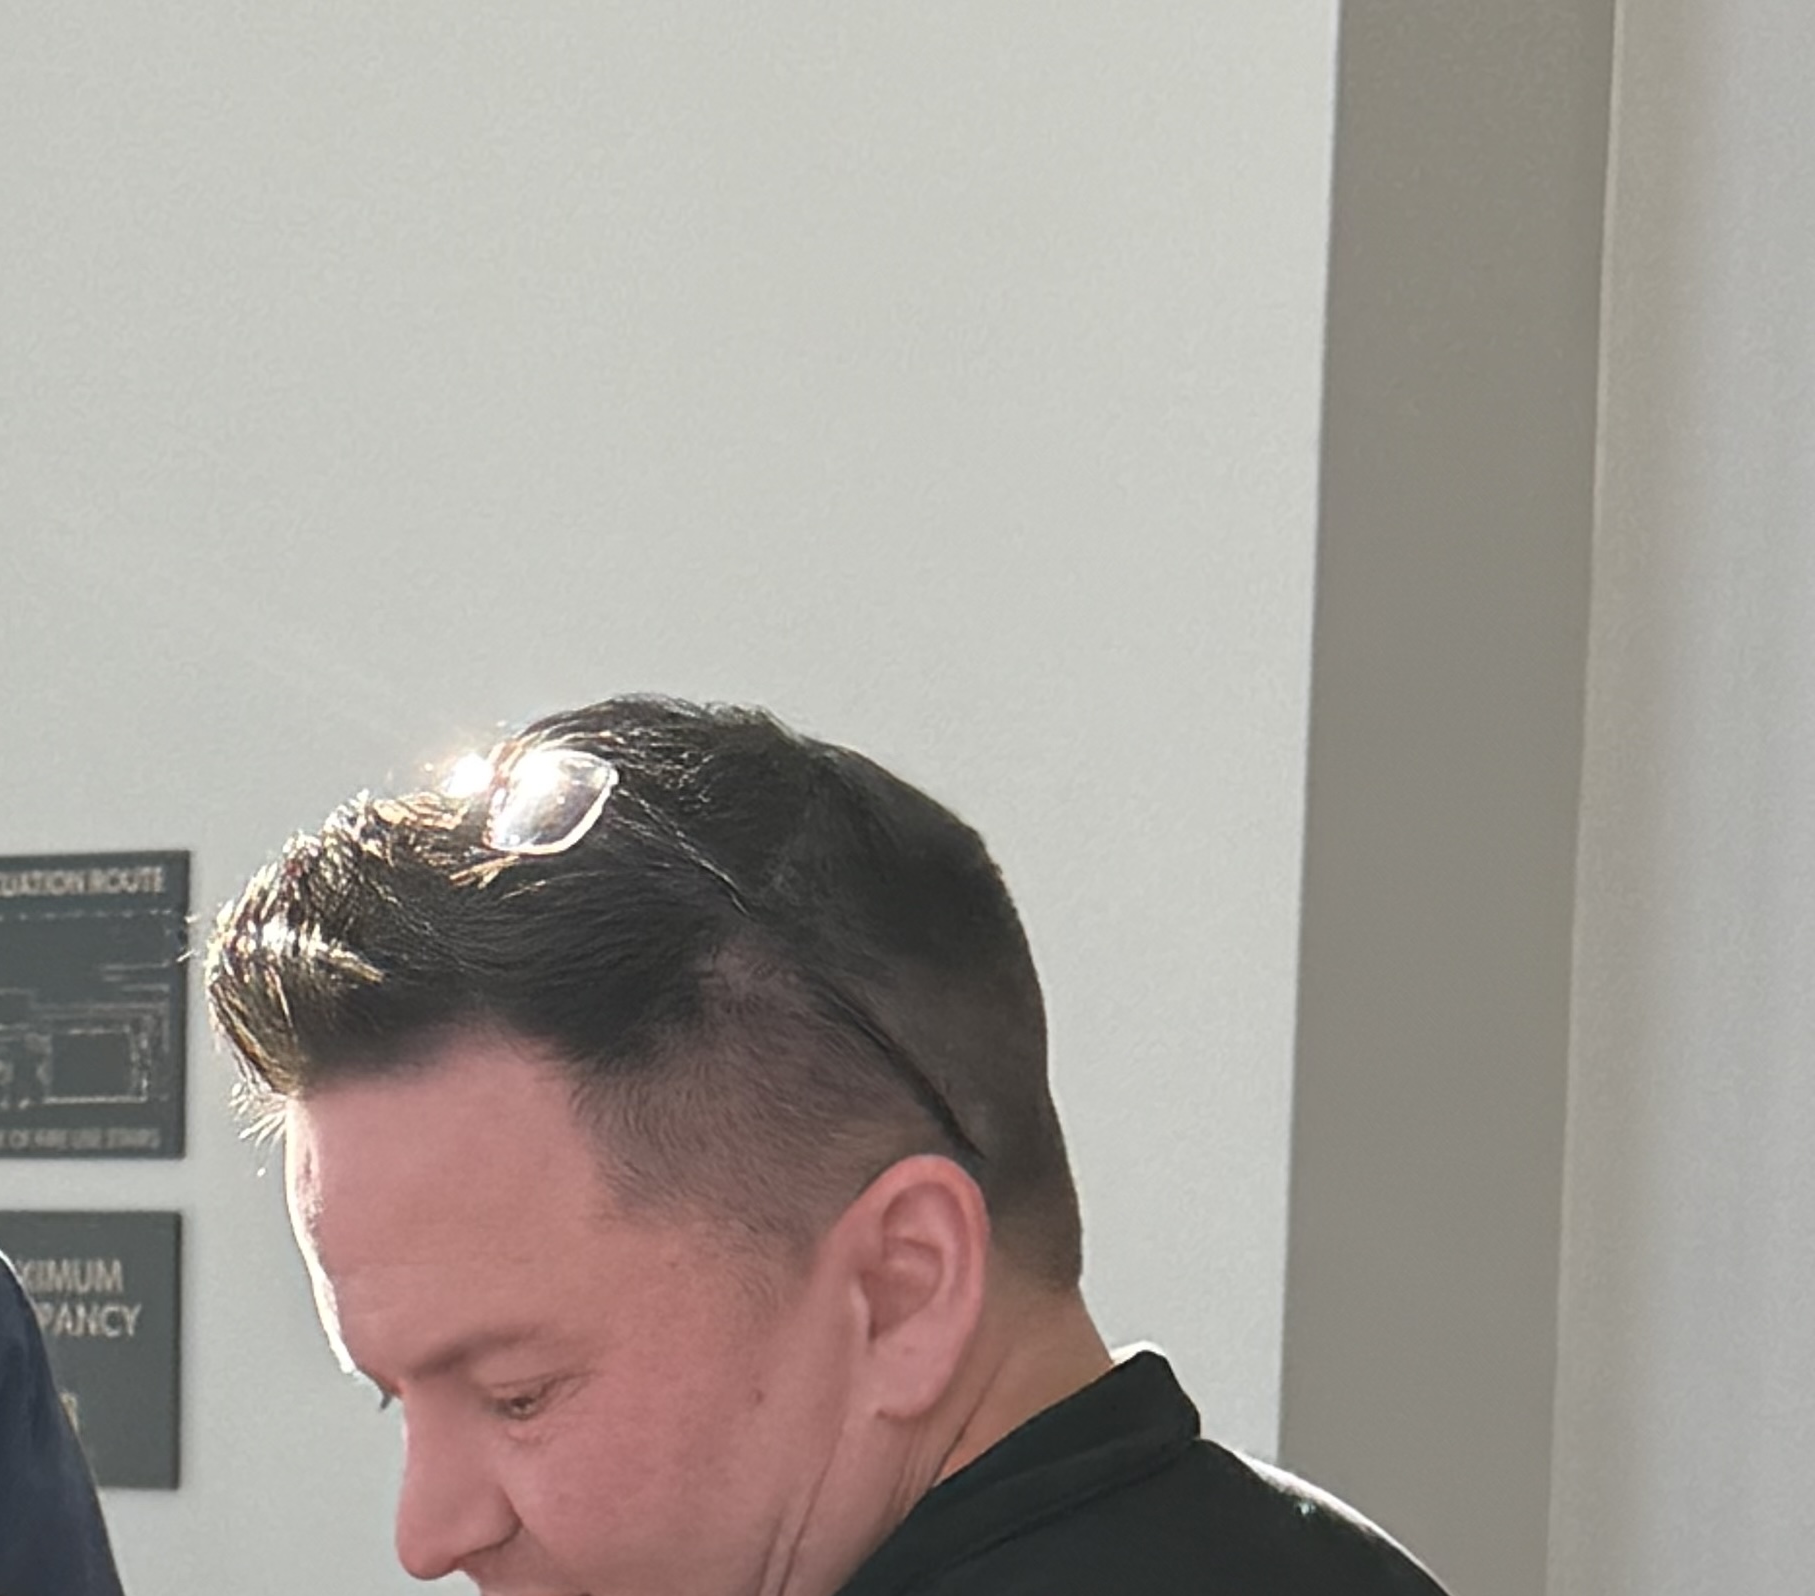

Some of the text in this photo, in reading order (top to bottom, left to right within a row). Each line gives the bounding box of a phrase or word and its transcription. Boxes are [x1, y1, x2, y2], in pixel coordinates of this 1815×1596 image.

[88, 866, 164, 894] ROUTE
[17, 1257, 124, 1294] XIMUM
[36, 1302, 142, 1338] PANCY
